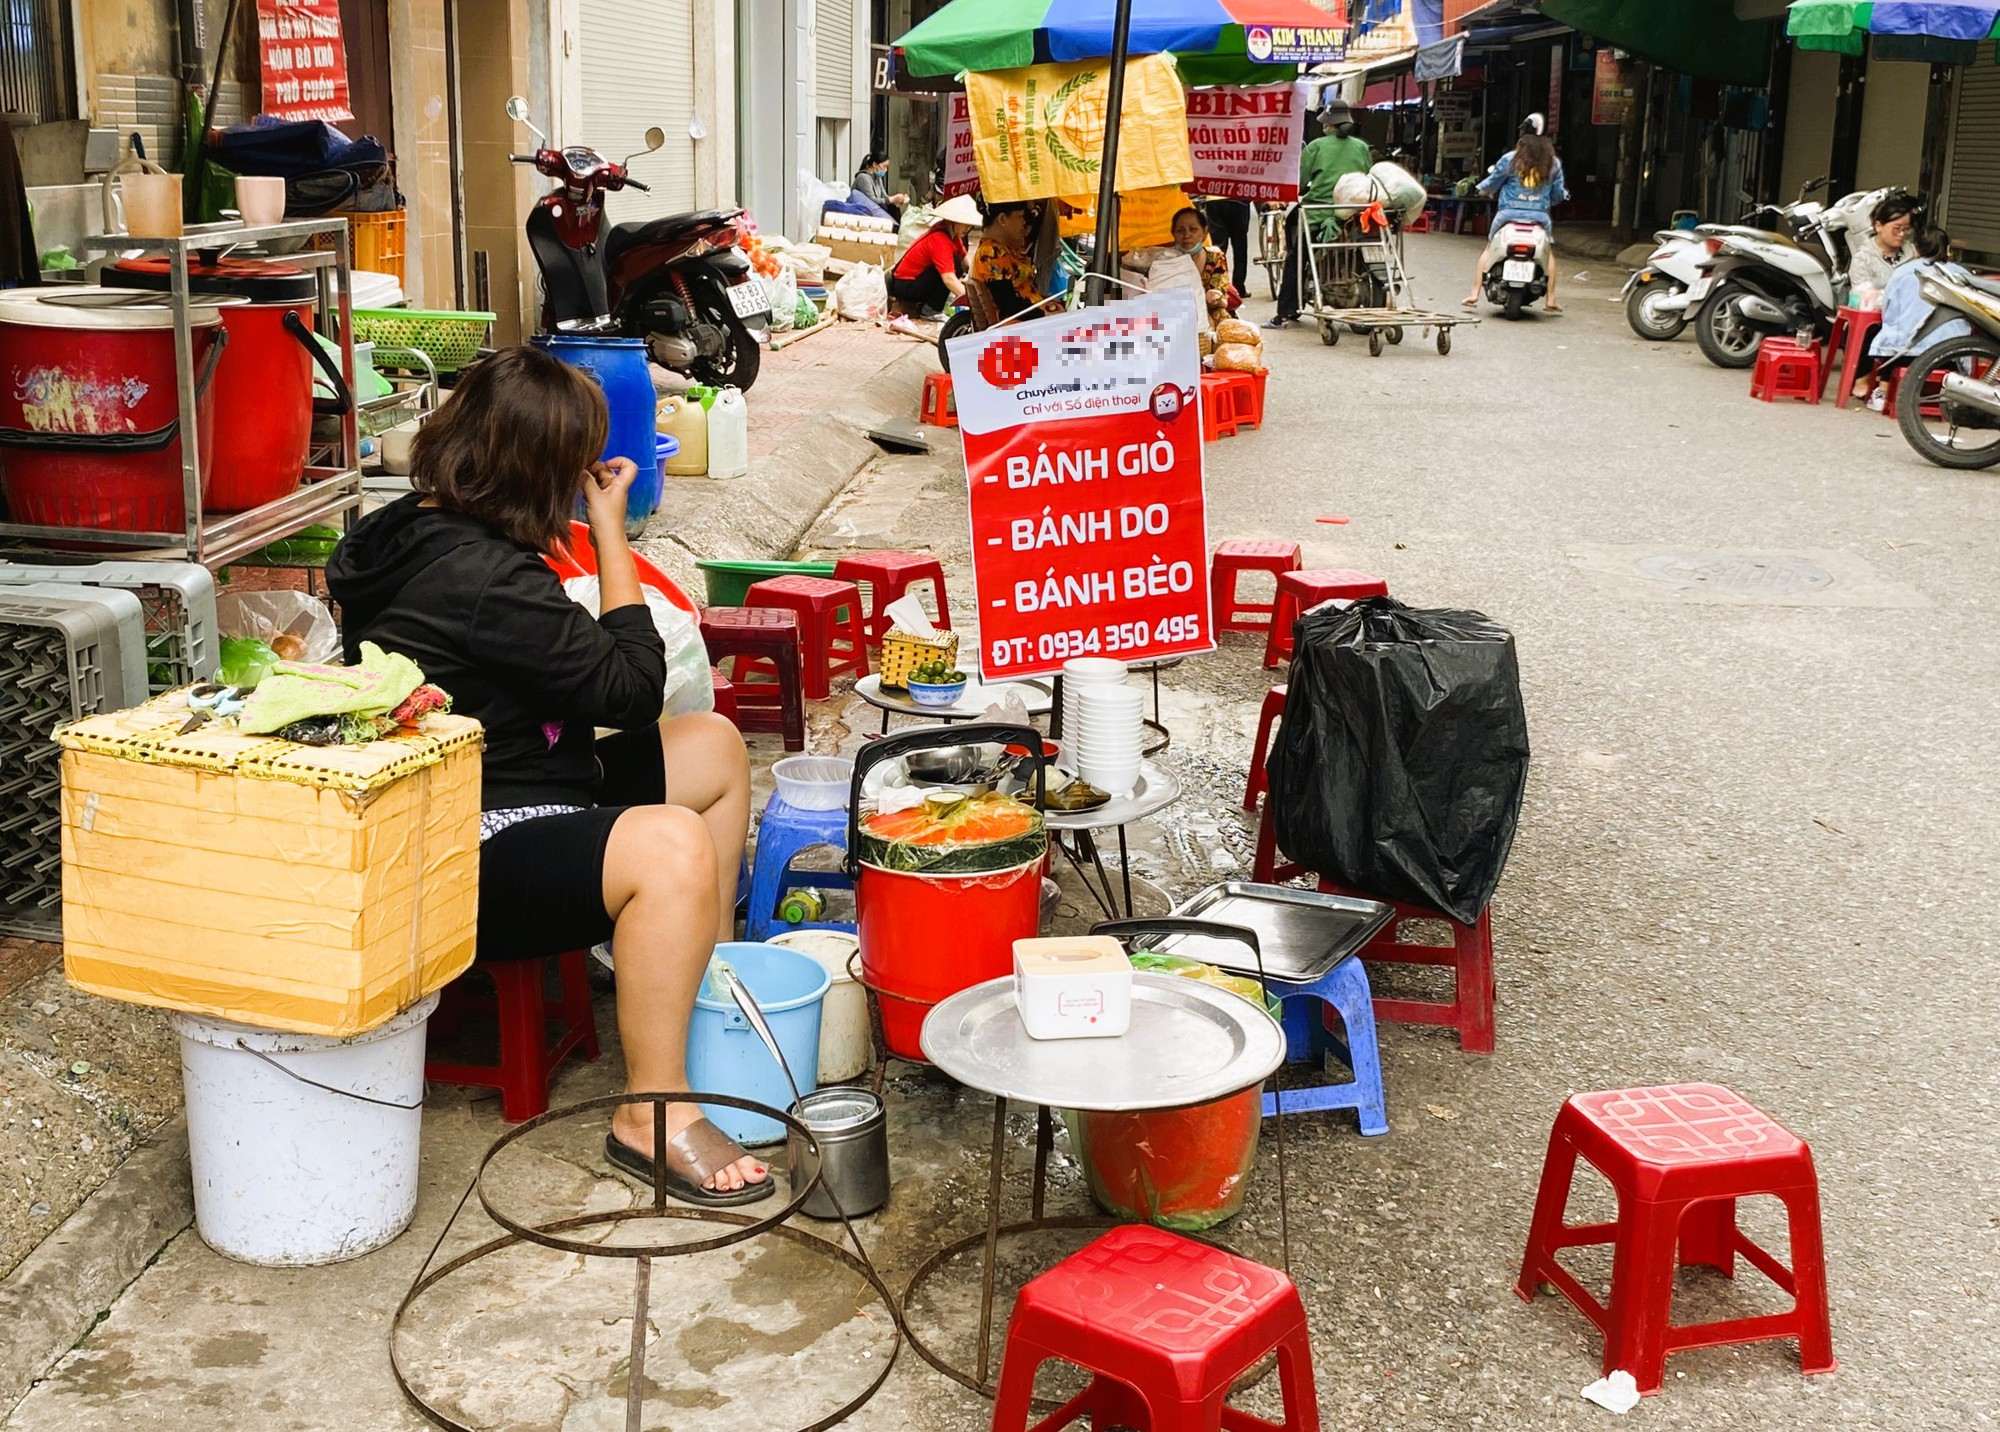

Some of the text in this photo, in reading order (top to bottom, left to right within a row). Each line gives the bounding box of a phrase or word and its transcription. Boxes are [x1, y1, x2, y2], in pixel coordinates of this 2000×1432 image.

[1272, 28, 1344, 46] KIM THANH
[295, 43, 311, 69] BÒ
[1186, 86, 1293, 116] BÌNH
[1187, 124, 1218, 145] XÔI
[1223, 121, 1251, 145] ĐỖ
[1194, 147, 1283, 166] CHÍNH HIỆU
[1207, 181, 1280, 200] 0917 398 944
[1065, 397, 1082, 411] Số
[1084, 394, 1110, 409] điện
[1111, 393, 1142, 407] thoại
[1006, 442, 1109, 489] BÁNH
[1117, 430, 1175, 477] GIÒ
[1011, 505, 1112, 551] BÁNH
[1119, 503, 1169, 539] DO
[1014, 566, 1116, 613] BÁNH
[1123, 554, 1194, 600] BÈO
[991, 614, 1200, 667] ĐT: 0934 350 495
